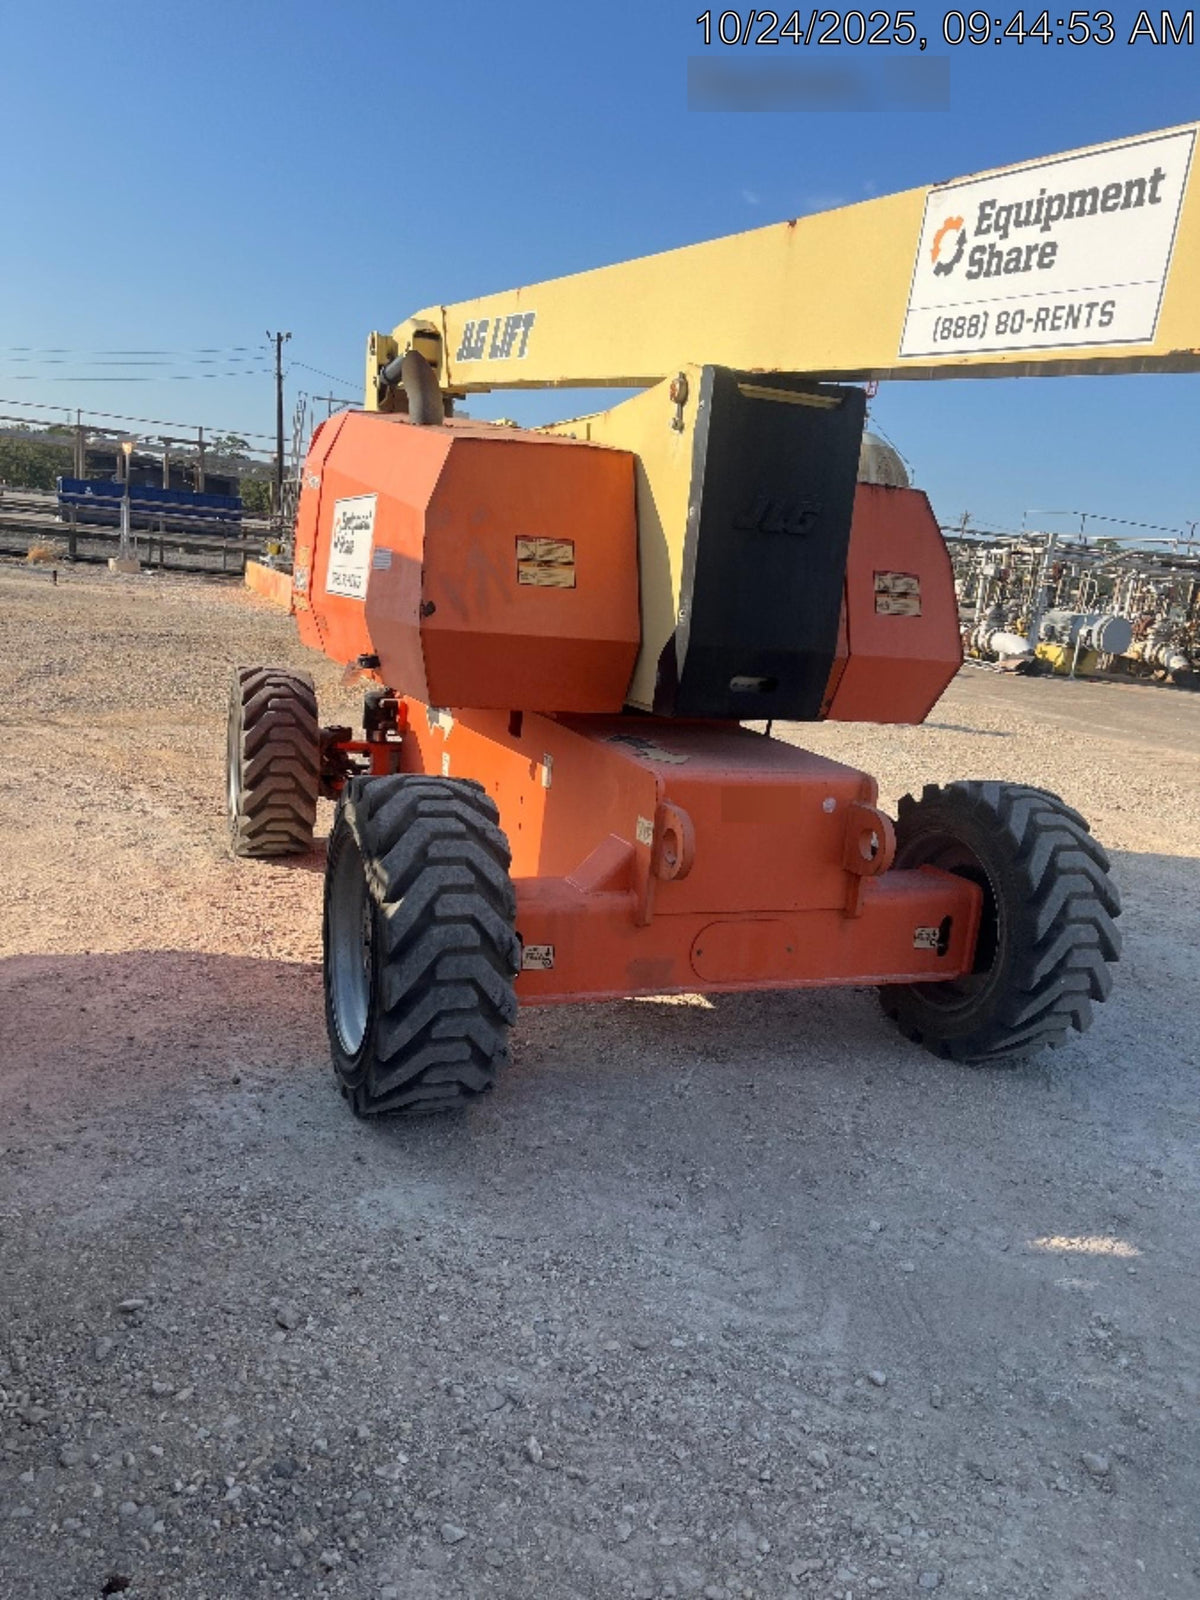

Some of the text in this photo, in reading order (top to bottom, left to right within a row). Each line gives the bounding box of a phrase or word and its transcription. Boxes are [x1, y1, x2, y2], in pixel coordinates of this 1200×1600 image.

[974, 166, 1166, 240] Equipment
[965, 241, 1058, 280] Share
[488, 312, 536, 360] LIFT
[933, 299, 1116, 342] (888) 80-RENTS
